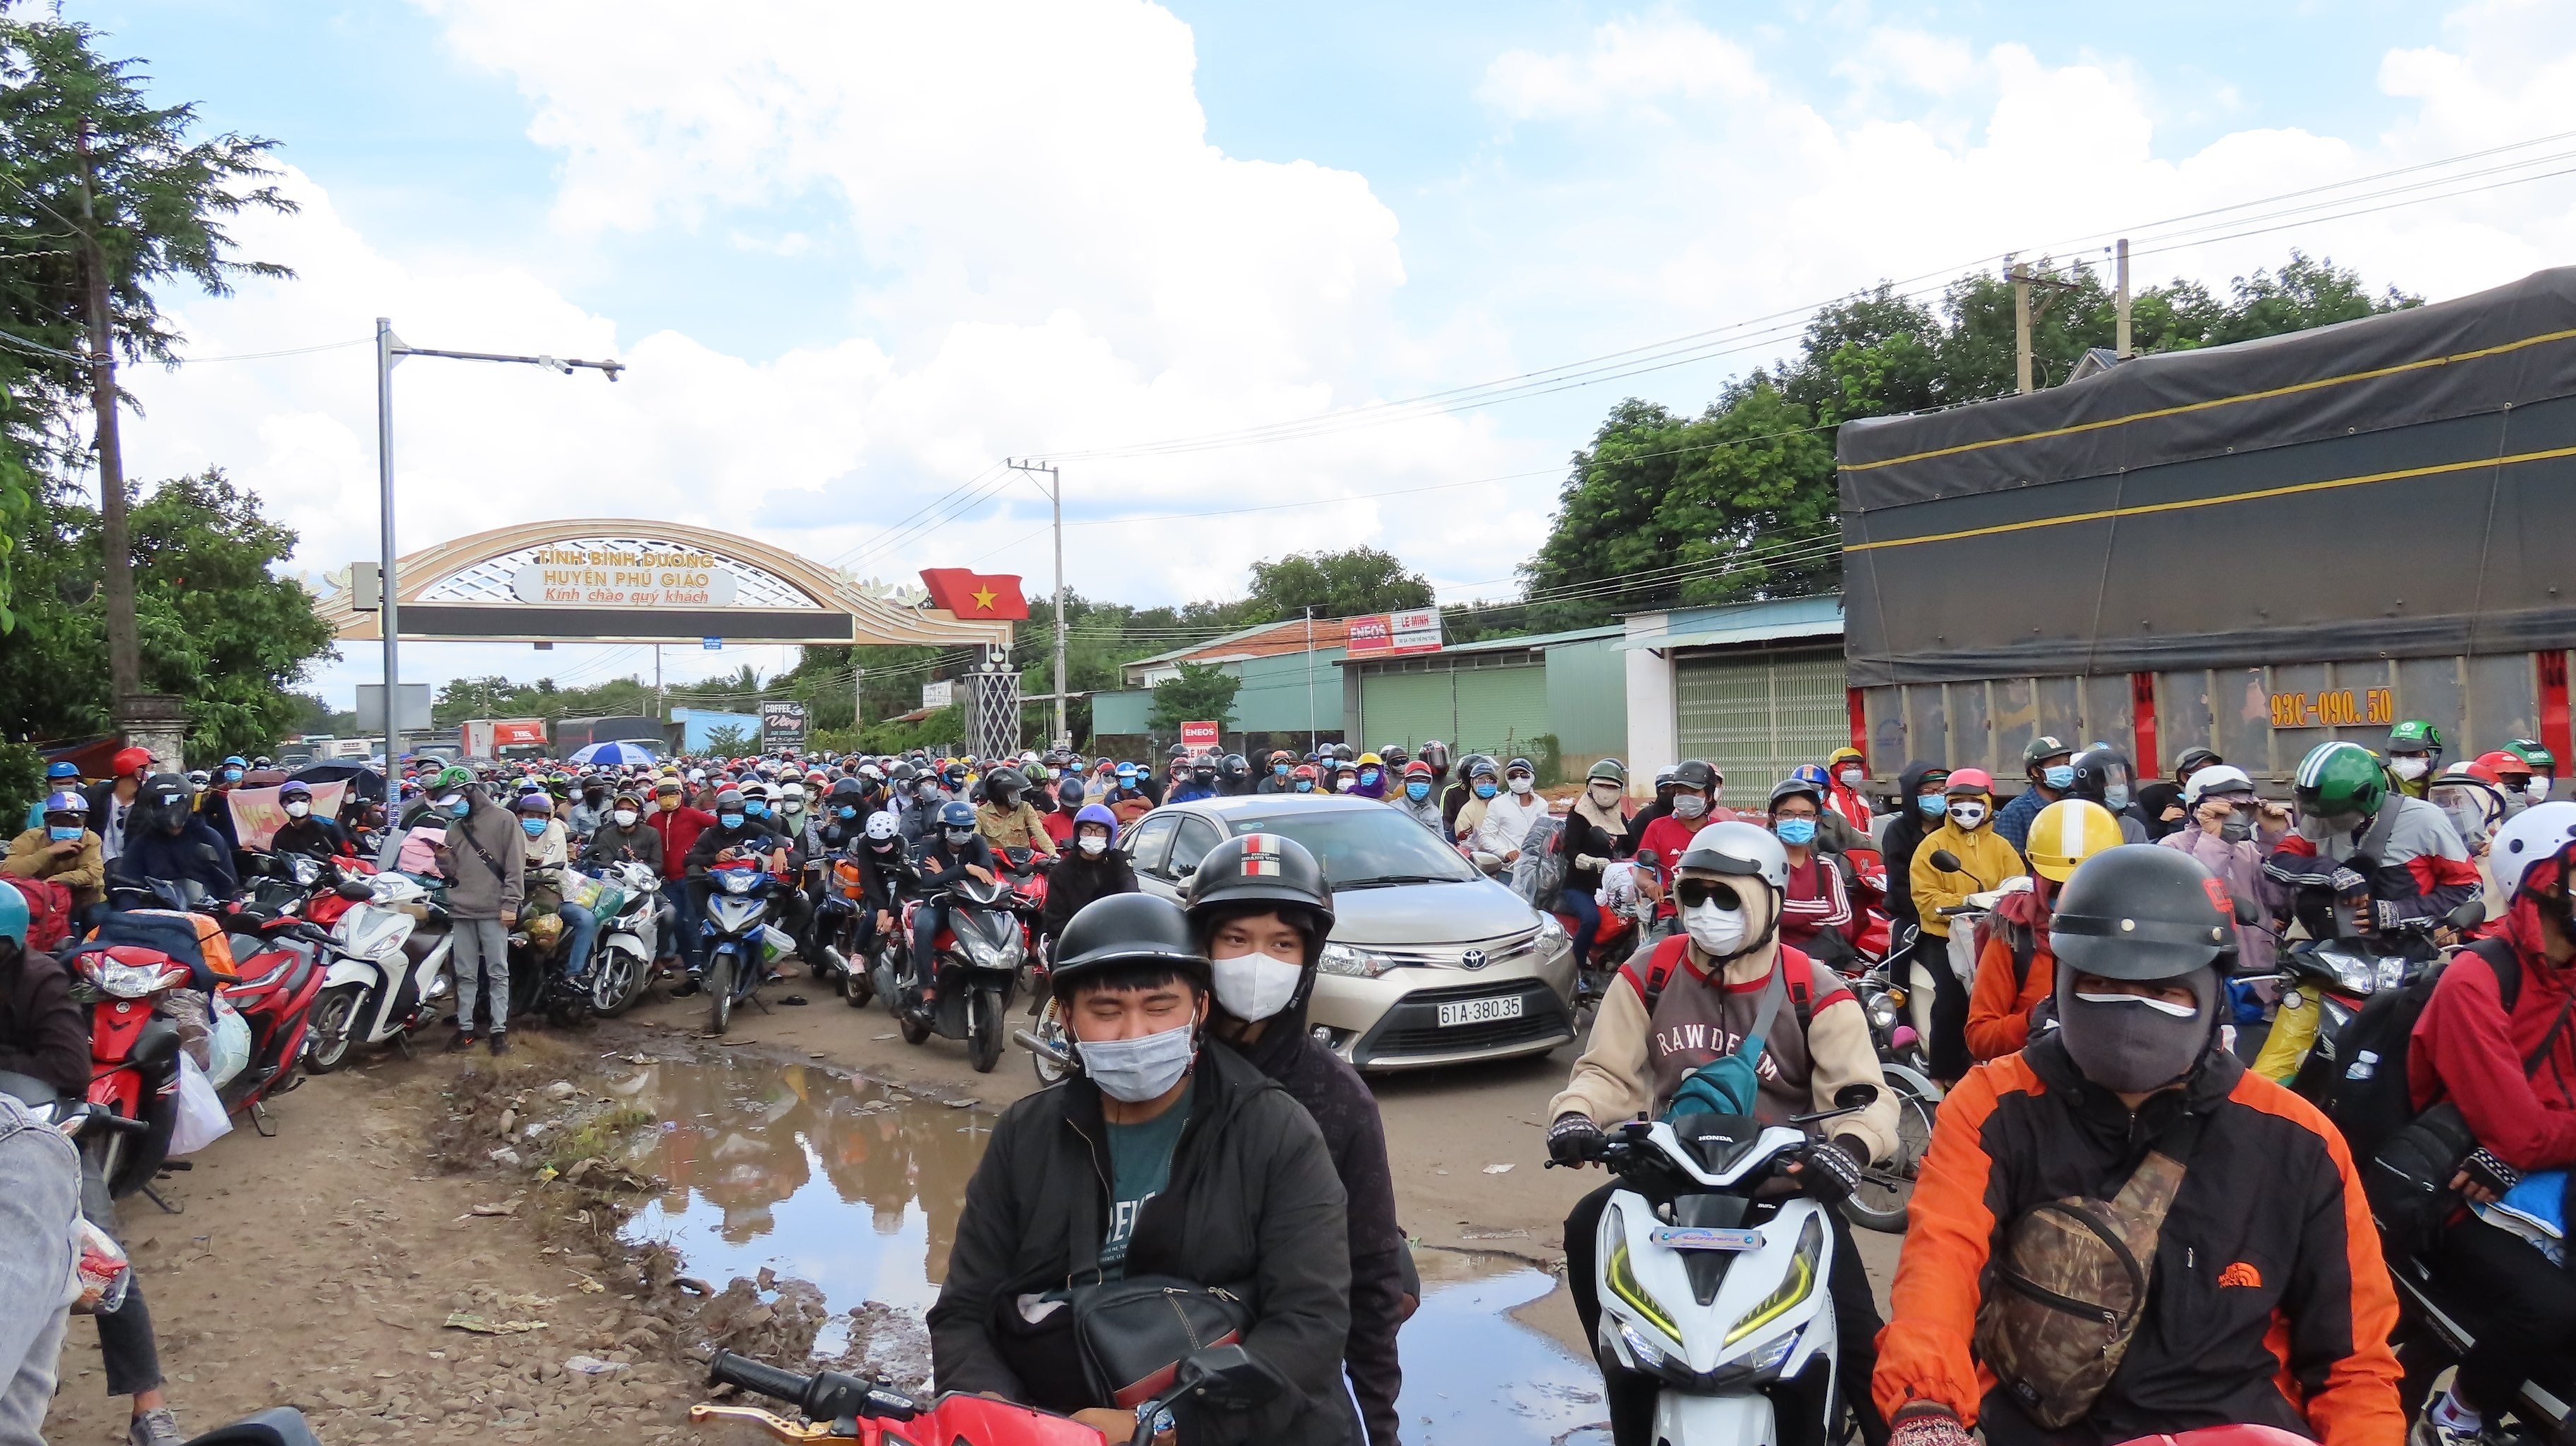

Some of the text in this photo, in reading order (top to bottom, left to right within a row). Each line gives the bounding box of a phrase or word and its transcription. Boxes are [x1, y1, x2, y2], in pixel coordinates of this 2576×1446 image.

[543, 567, 709, 590] HUYỆN PHÚ GIÁO
[545, 587, 709, 604] Kính chào quý khách
[1412, 614, 1429, 627] MINH
[1349, 624, 1387, 640] ENEOS
[765, 704, 791, 713] COFFEE
[1441, 998, 1520, 1023] 61A-380.35
[1656, 1024, 1777, 1081] RAW DEM
